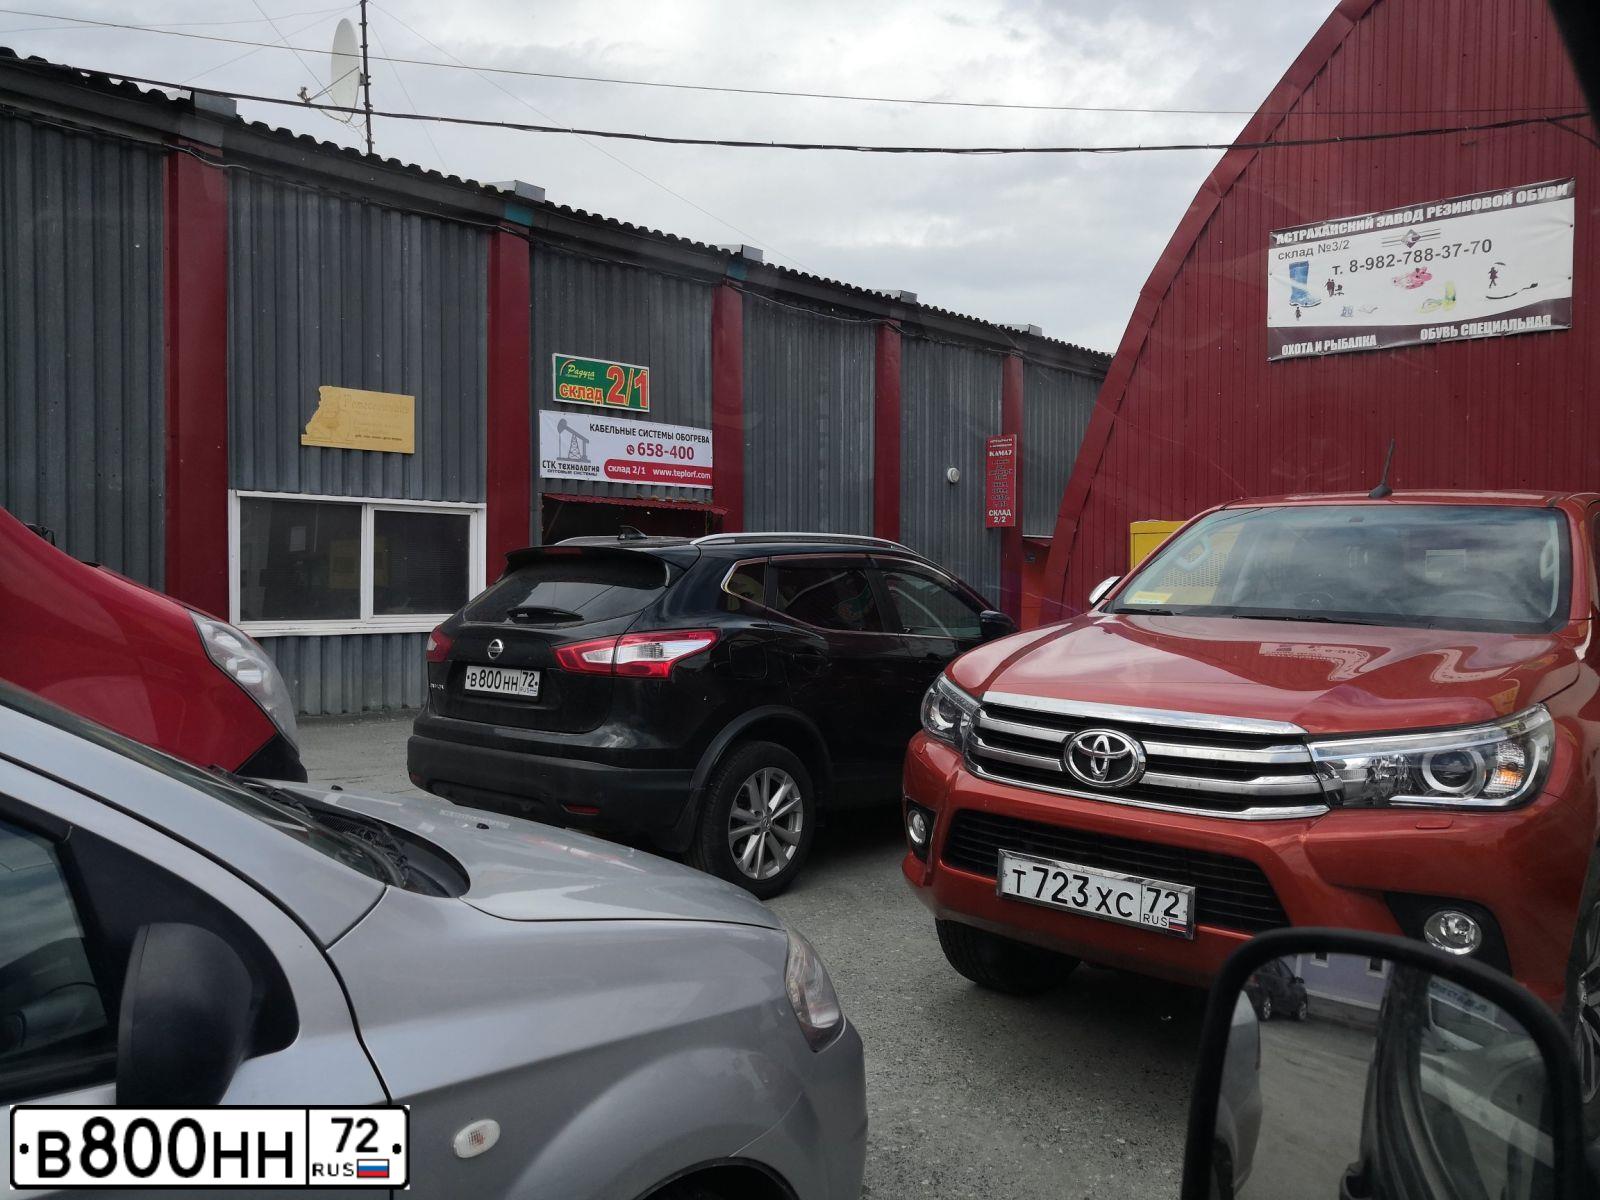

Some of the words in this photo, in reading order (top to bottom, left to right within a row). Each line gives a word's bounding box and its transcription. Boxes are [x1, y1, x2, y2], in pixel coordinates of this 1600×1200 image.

[1276, 216, 1374, 245] АСТРАХАНСКИЙ
[1377, 208, 1424, 227] ЗАВОД
[1427, 191, 1513, 218] РЕЗИНОВОЙ
[1516, 183, 1568, 203] ОБУВИ
[1278, 247, 1314, 260] склад
[1318, 240, 1350, 254] №3/2
[1332, 265, 1343, 276] т.
[1349, 239, 1492, 273] 8-982-788-37-70
[1420, 327, 1458, 341] ОБУВЬ
[1460, 315, 1552, 336] СПЕЦИАЛЬНАЯ
[1281, 341, 1314, 356] ОХОТА
[1315, 340, 1323, 352] И
[1324, 334, 1377, 351] РЫБАЛКА
[567, 364, 595, 378] Радуга
[606, 365, 648, 408] 2/1
[589, 423, 636, 436] КАБЕЛЬНЫЕ
[638, 428, 674, 440] СИСТЕМЫ
[676, 432, 710, 444] ОБОГРЕВА
[637, 442, 694, 460] 658-400
[542, 460, 557, 470] СТК
[607, 465, 631, 475] склад
[632, 465, 646, 475] 2/1
[653, 468, 711, 480] www.teplorf.com
[988, 509, 1012, 517] СКЛАД
[993, 516, 1006, 524] 2/2
[522, 671, 535, 688] 72
[1147, 887, 1180, 919] 72
[1143, 913, 1168, 927] RUS
